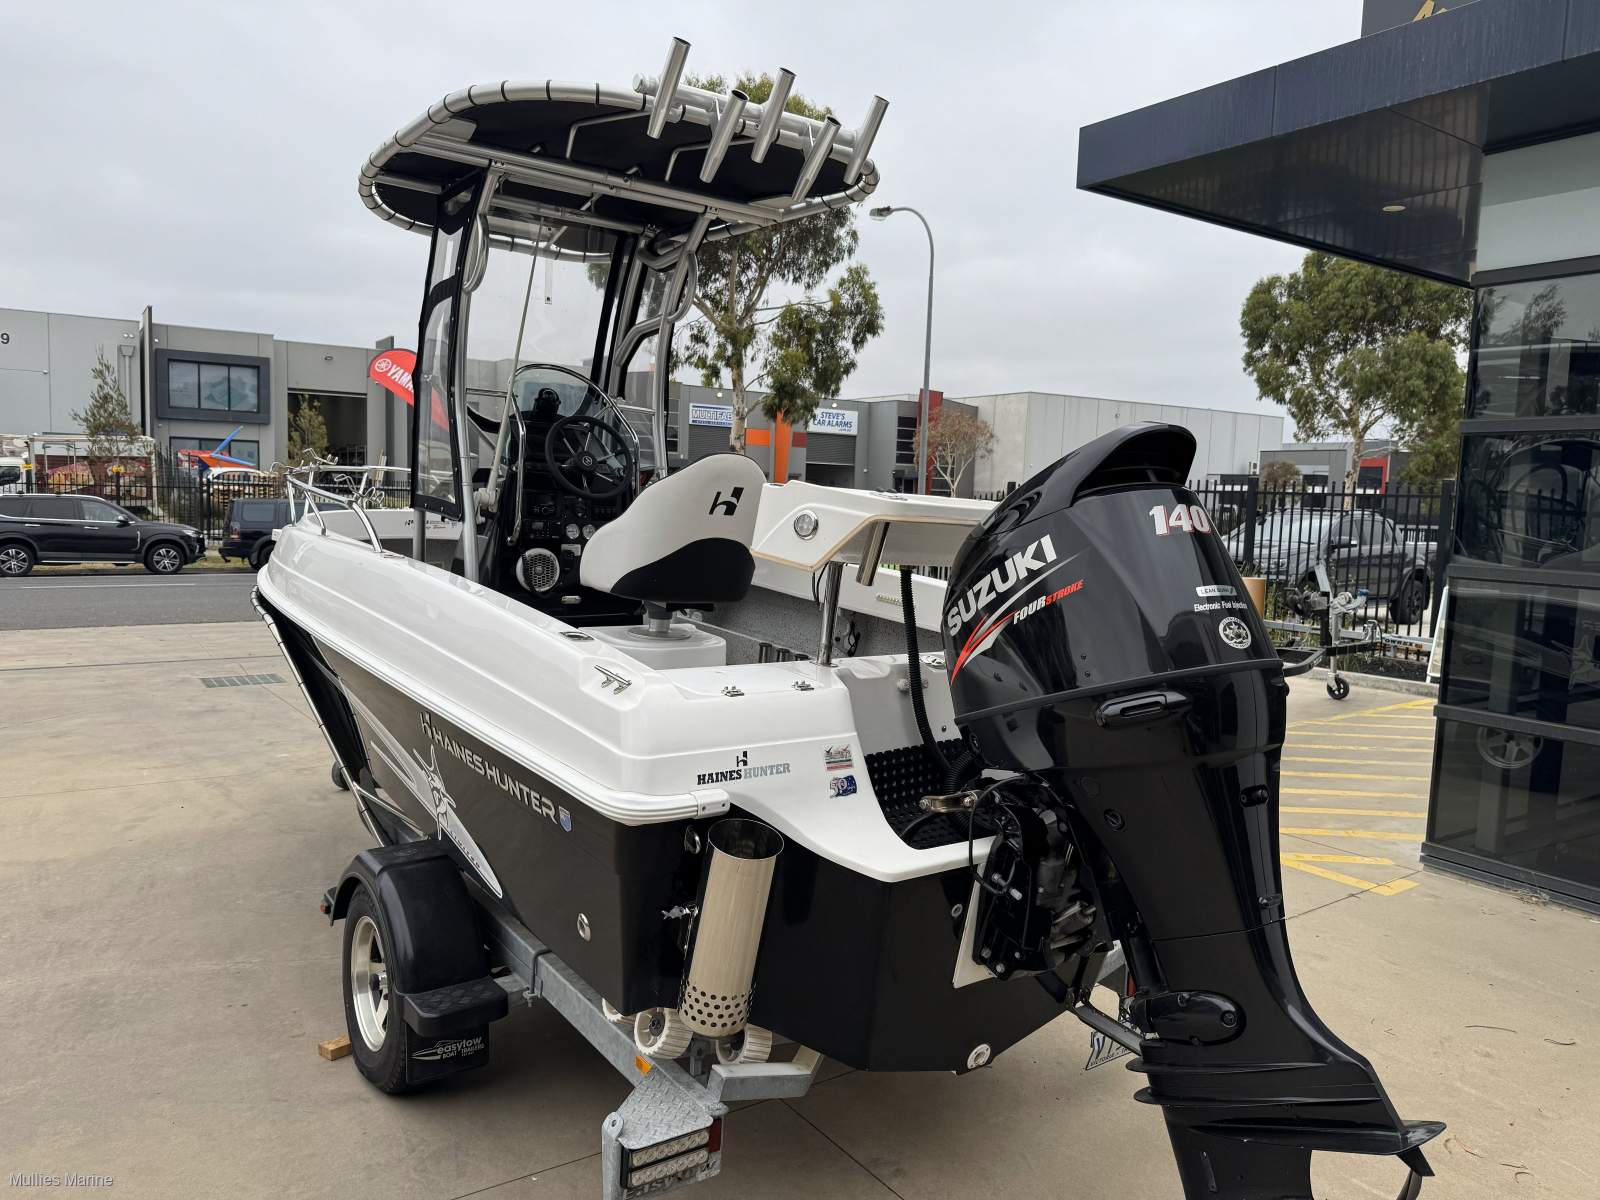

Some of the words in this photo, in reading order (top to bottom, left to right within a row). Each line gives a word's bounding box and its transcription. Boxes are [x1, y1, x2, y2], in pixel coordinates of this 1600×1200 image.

[387, 364, 414, 393] YAMA
[813, 418, 826, 426] CAR
[826, 420, 853, 428] ALARMS
[820, 411, 846, 420] STEVE'S
[1149, 503, 1213, 536] 140
[946, 533, 1057, 637] SUZUKI
[1194, 602, 1221, 612] Electronic
[432, 725, 485, 775] HAINES
[485, 761, 557, 824] HUNTER
[697, 769, 743, 785] HAINES
[743, 763, 791, 779] HUNTER
[437, 1036, 482, 1054] easytow
